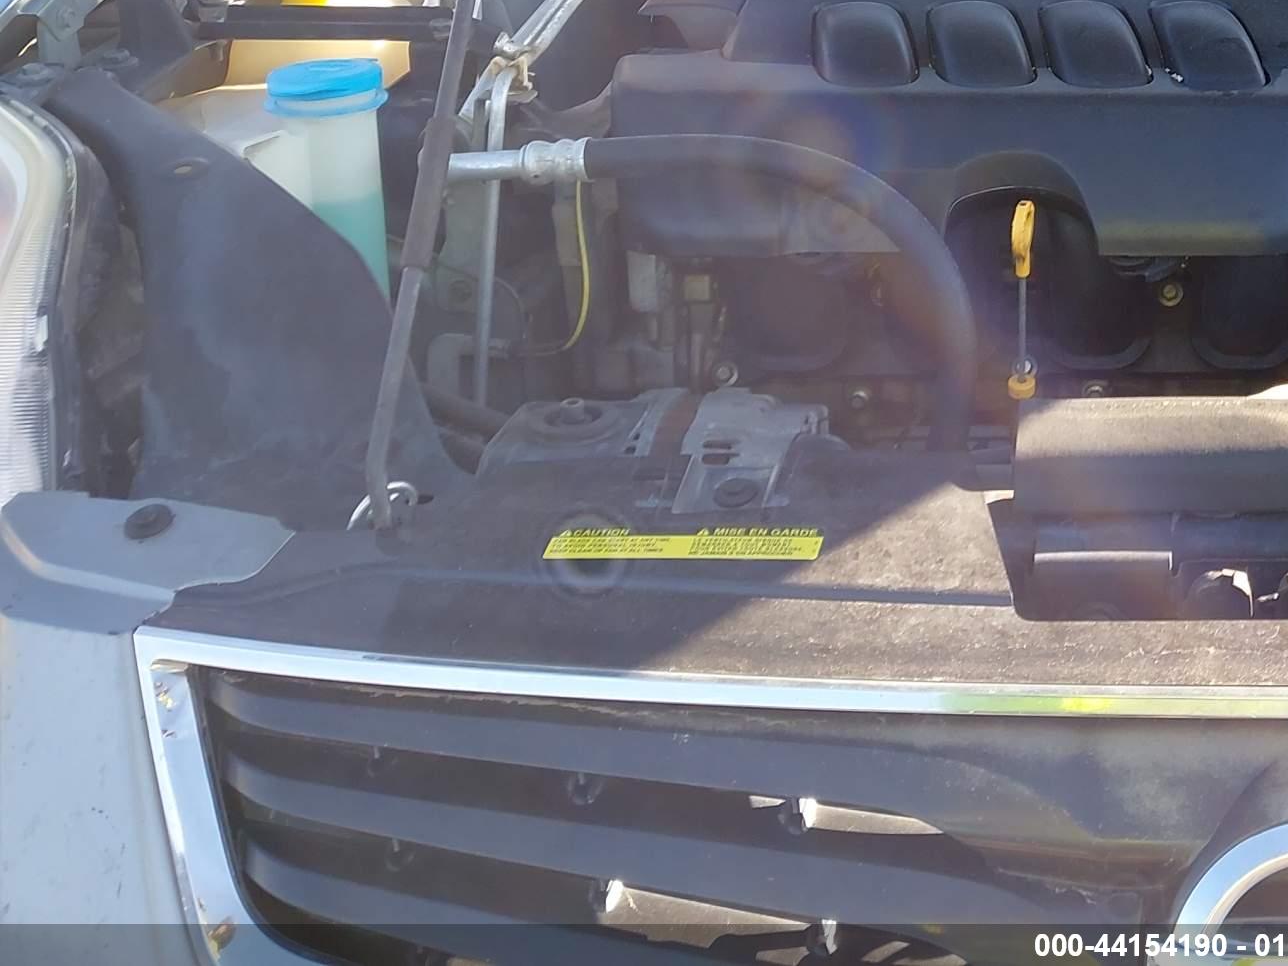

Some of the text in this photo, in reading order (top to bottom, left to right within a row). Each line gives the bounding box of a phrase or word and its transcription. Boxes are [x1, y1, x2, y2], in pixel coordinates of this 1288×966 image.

[573, 527, 631, 538] CAUTION
[713, 527, 746, 537] MISE
[770, 527, 818, 538] GARDE
